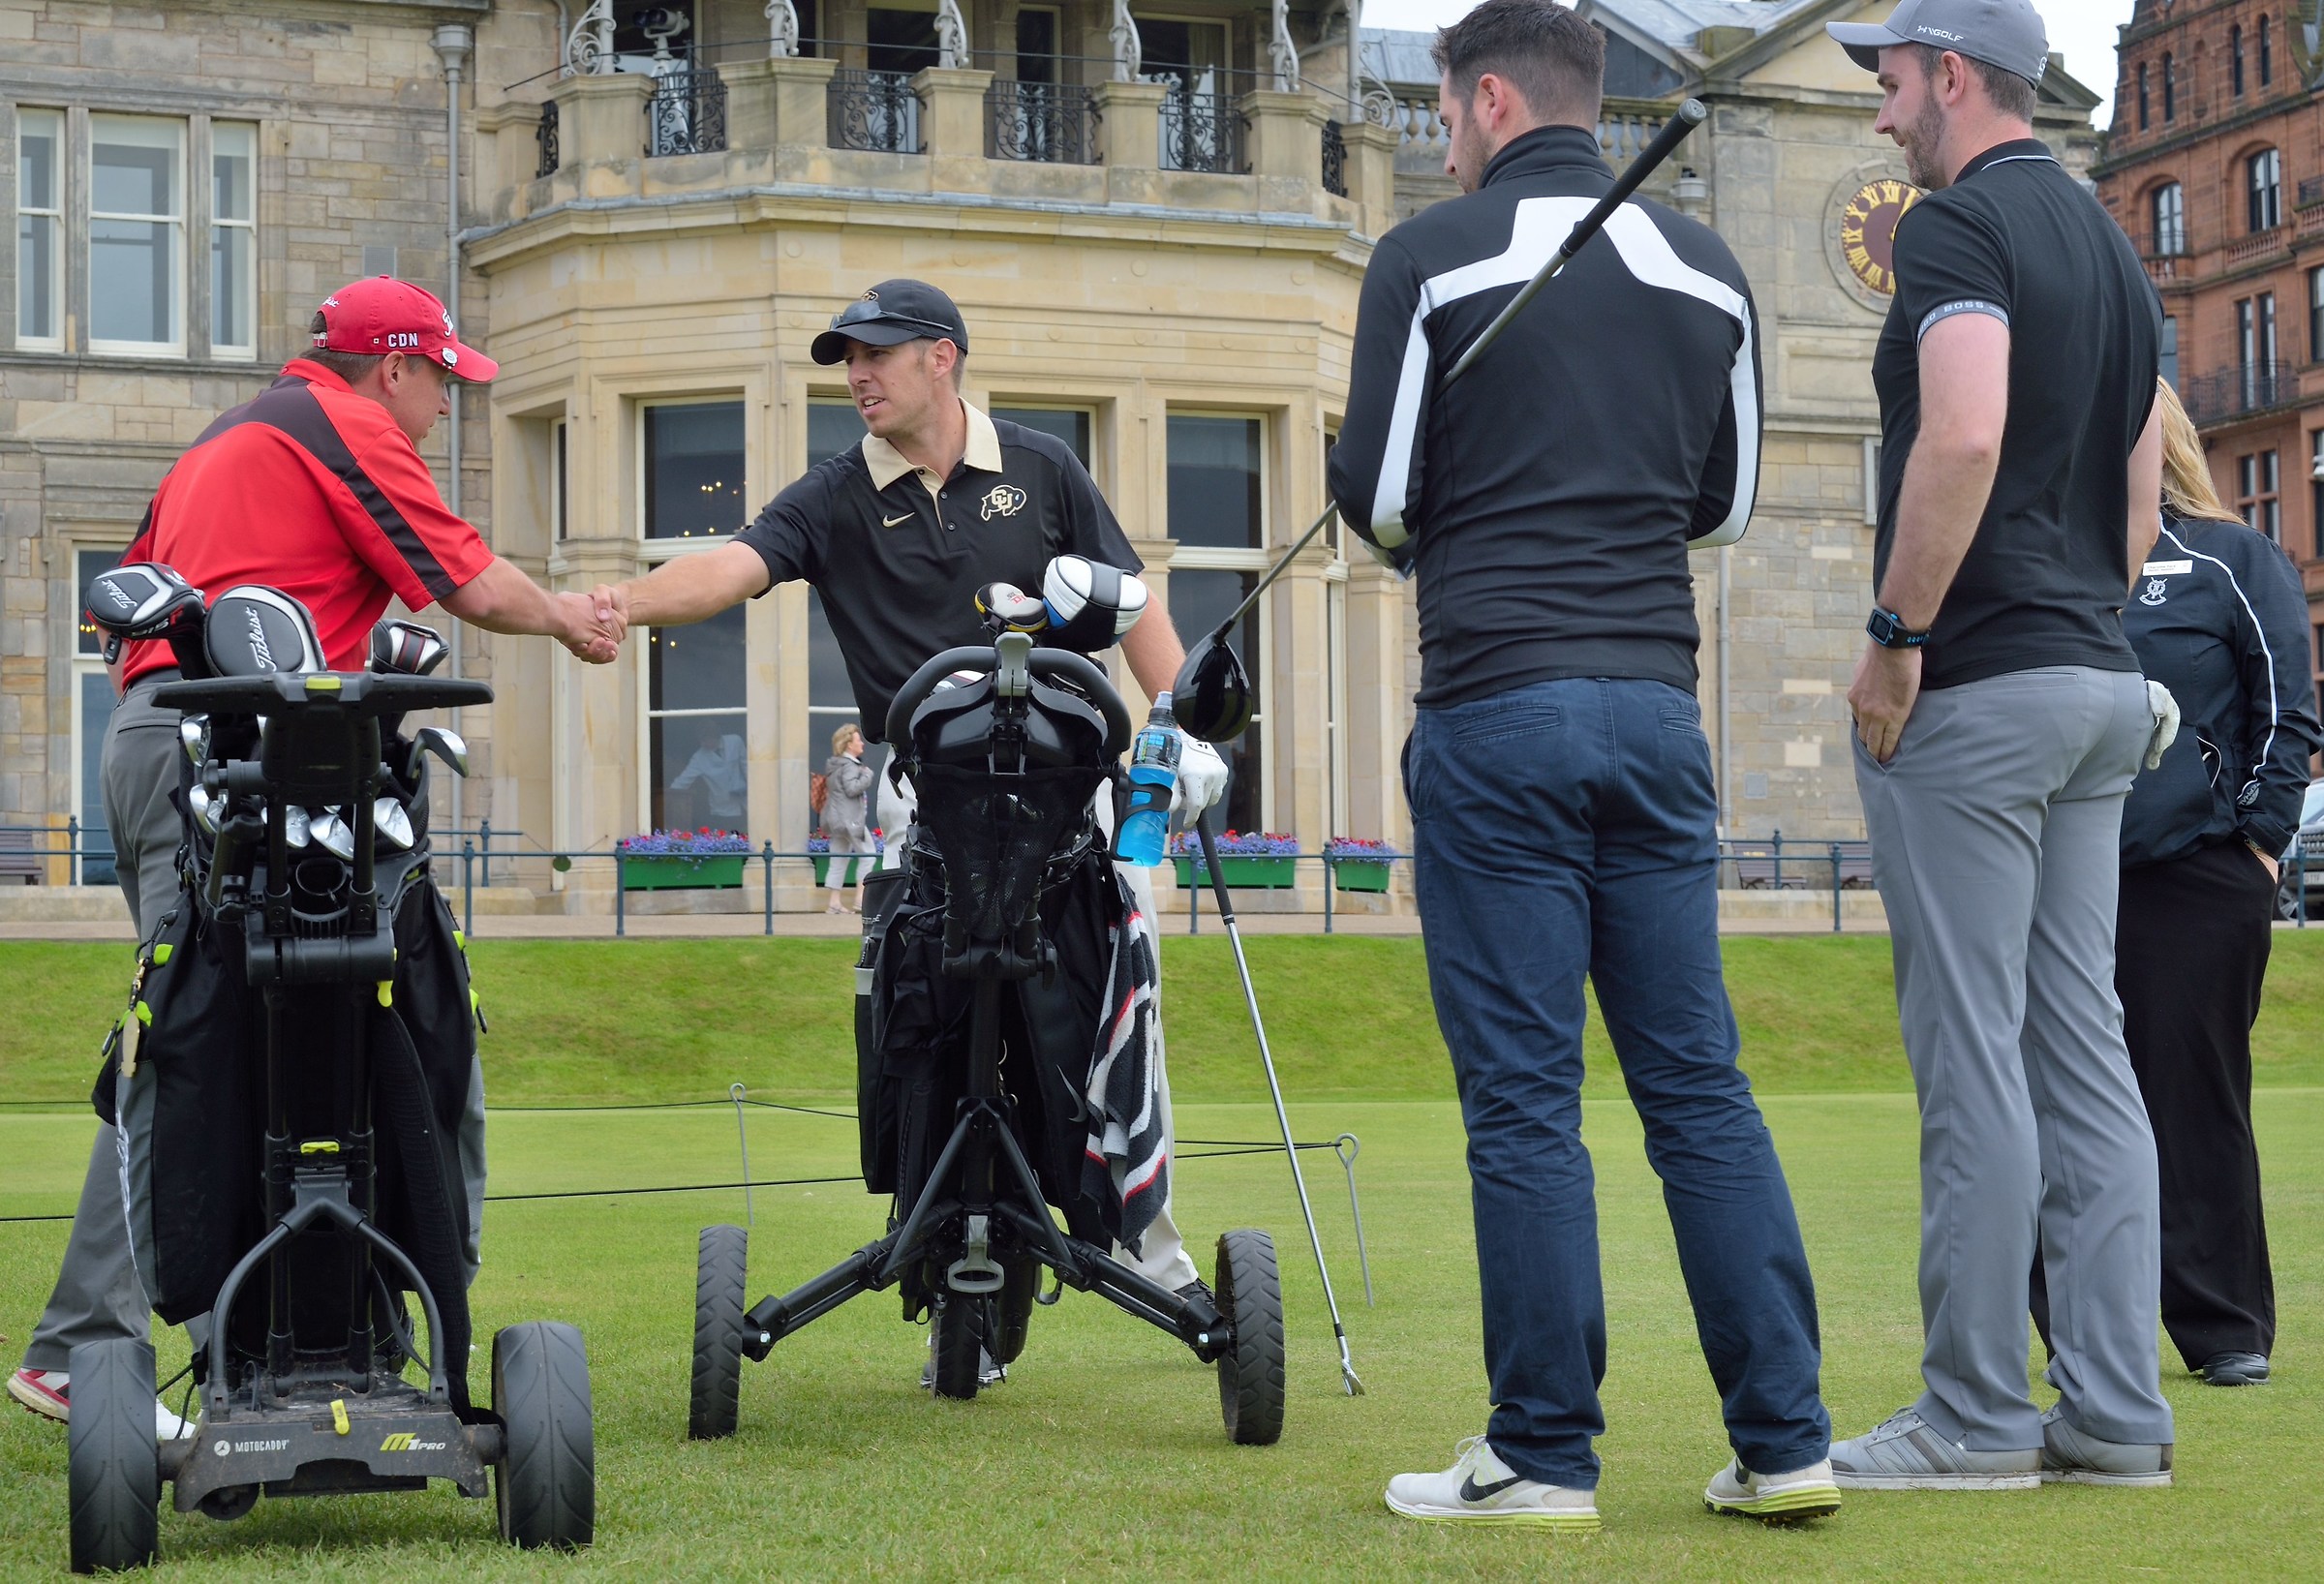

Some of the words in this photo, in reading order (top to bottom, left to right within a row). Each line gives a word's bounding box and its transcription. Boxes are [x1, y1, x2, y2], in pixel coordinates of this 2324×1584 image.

[1933, 28, 1965, 43] GOLF
[1943, 301, 1984, 313] BOSS
[387, 332, 418, 348] CDN
[991, 489, 1013, 509] CU
[102, 579, 138, 609] Titleist
[244, 606, 278, 673] Titleist
[234, 1439, 290, 1452] MOTOCADDY
